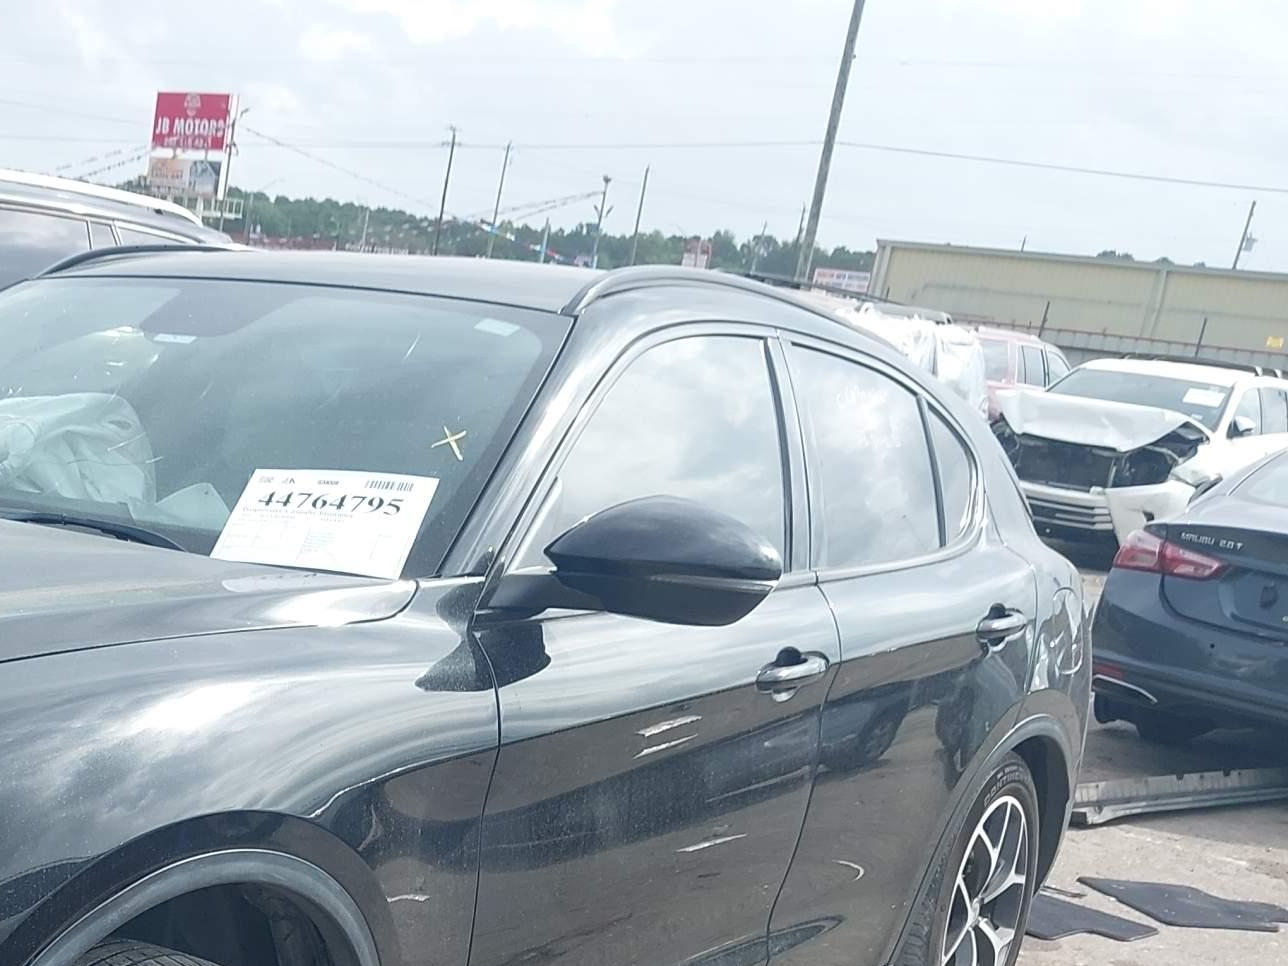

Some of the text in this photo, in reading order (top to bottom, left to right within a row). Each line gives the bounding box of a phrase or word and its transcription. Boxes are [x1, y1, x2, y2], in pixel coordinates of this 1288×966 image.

[155, 116, 226, 138] JB MOTORS
[258, 491, 404, 516] 44764795
